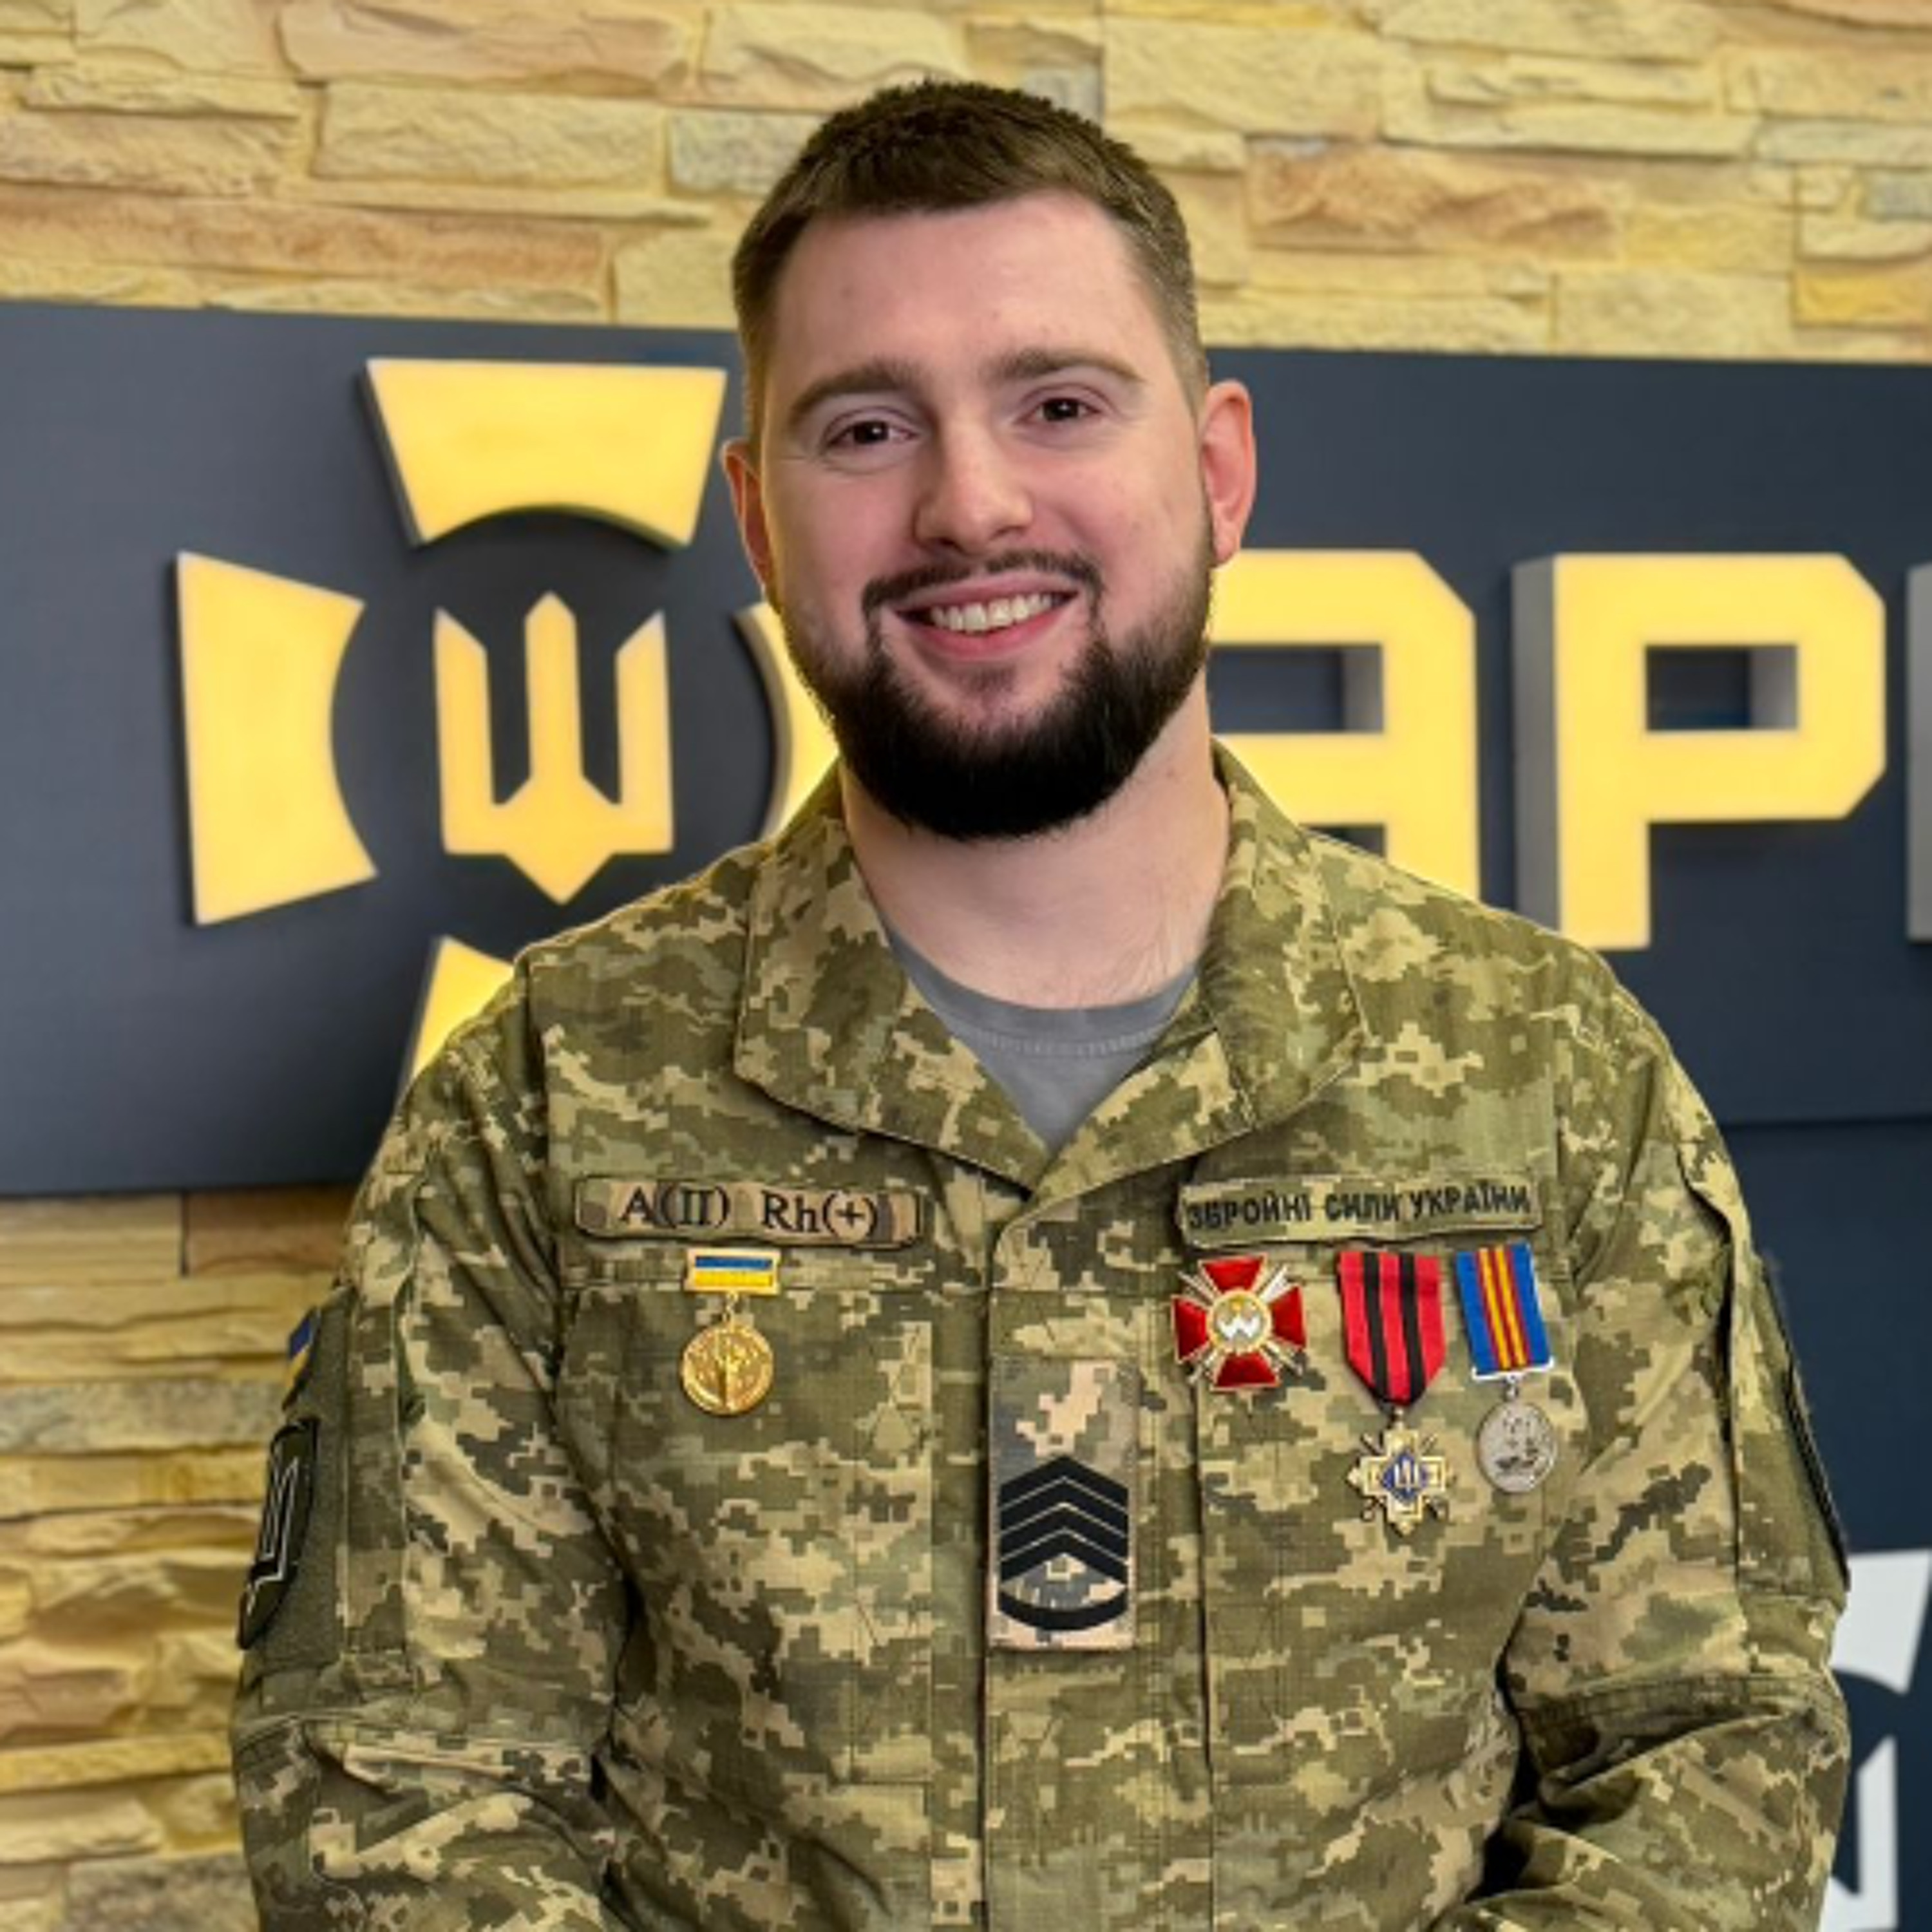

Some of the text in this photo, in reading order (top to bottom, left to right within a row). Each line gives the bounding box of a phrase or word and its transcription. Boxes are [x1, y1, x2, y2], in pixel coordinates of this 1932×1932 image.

[1207, 549, 1932, 950] АР
[760, 1189, 878, 1245] Rh(+)
[1186, 1180, 1531, 1229] ЗБРОЙНІ СИЛИ УКРАЇНИ
